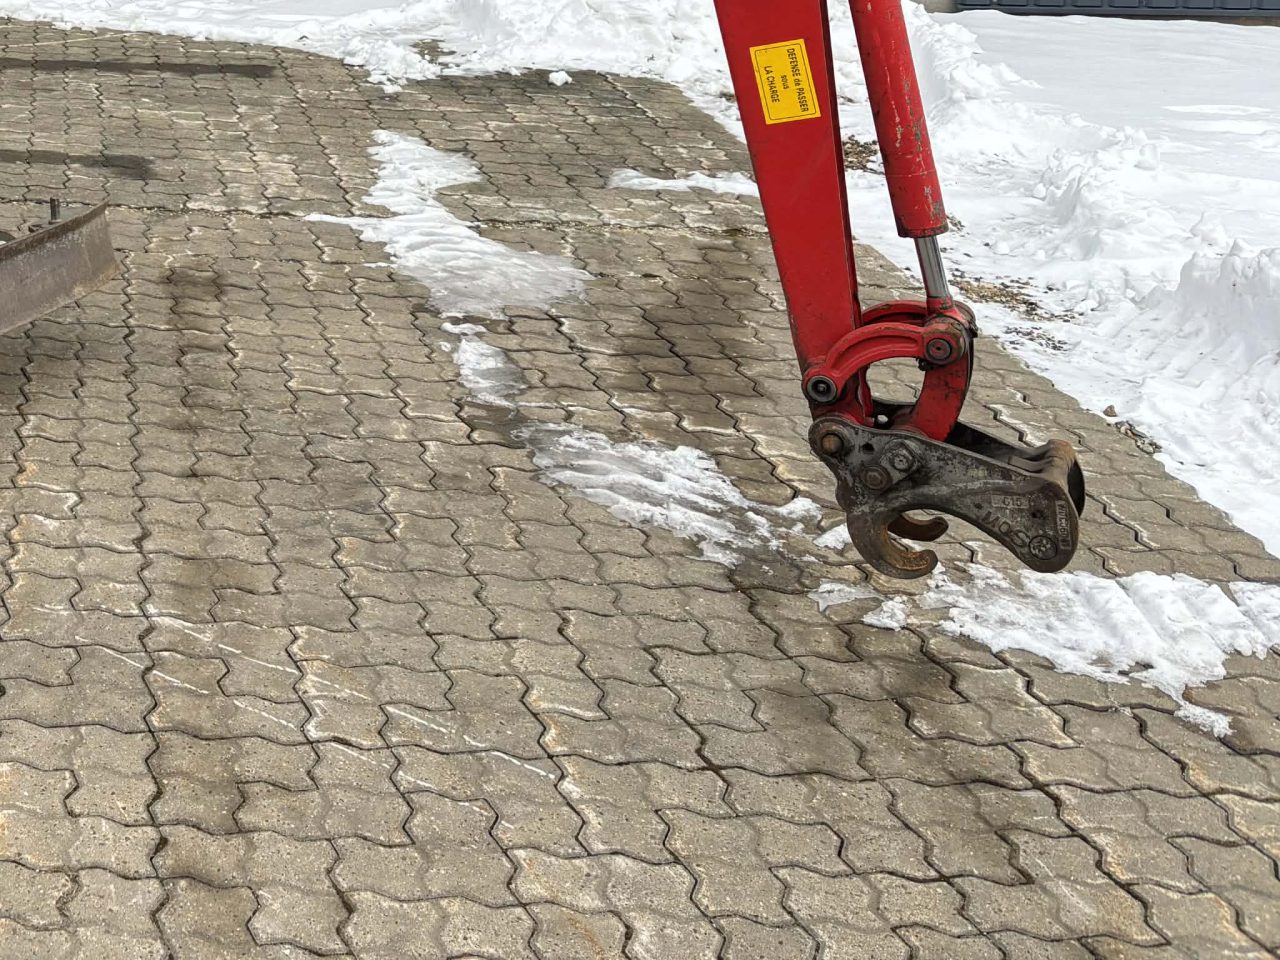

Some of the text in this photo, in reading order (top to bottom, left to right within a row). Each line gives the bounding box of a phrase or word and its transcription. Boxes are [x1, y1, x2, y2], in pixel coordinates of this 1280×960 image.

[764, 65, 781, 103] LA CHARGE
[787, 48, 809, 113] DEFENSE de PASSER
